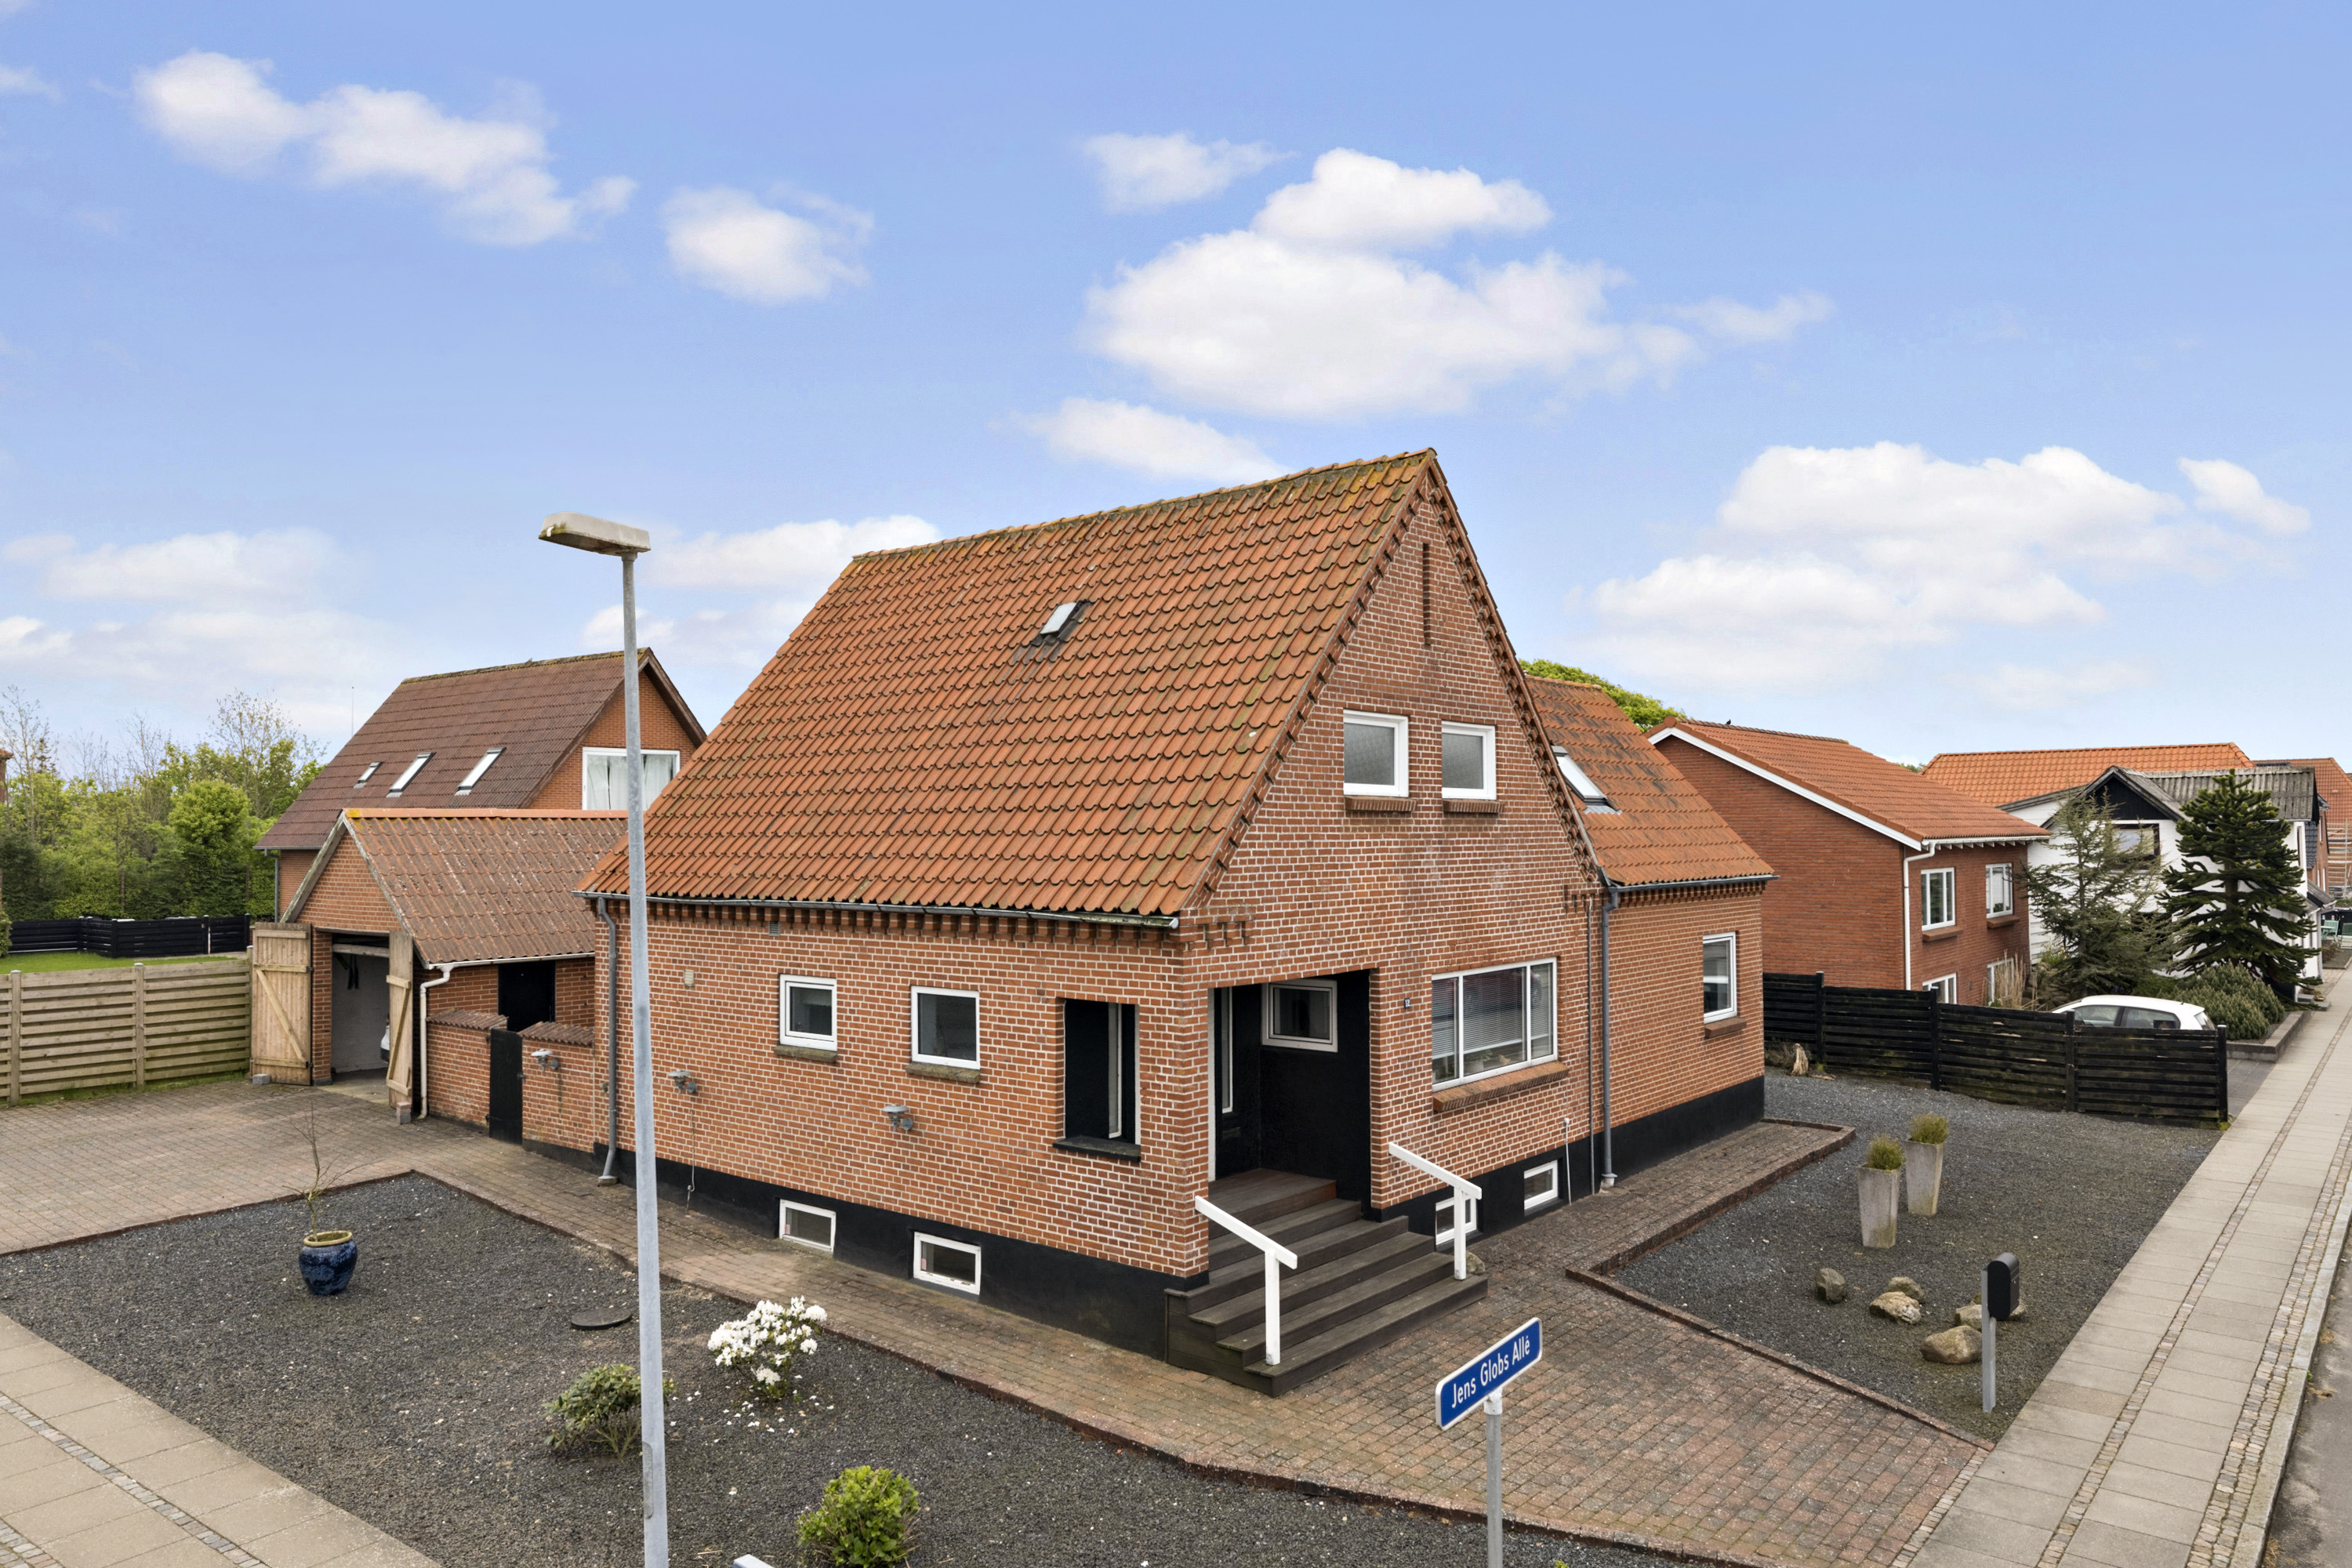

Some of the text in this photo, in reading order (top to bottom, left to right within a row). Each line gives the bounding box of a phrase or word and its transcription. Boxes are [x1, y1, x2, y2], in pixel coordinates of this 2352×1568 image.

[1451, 1335, 1530, 1409] Jens Globs Allé
